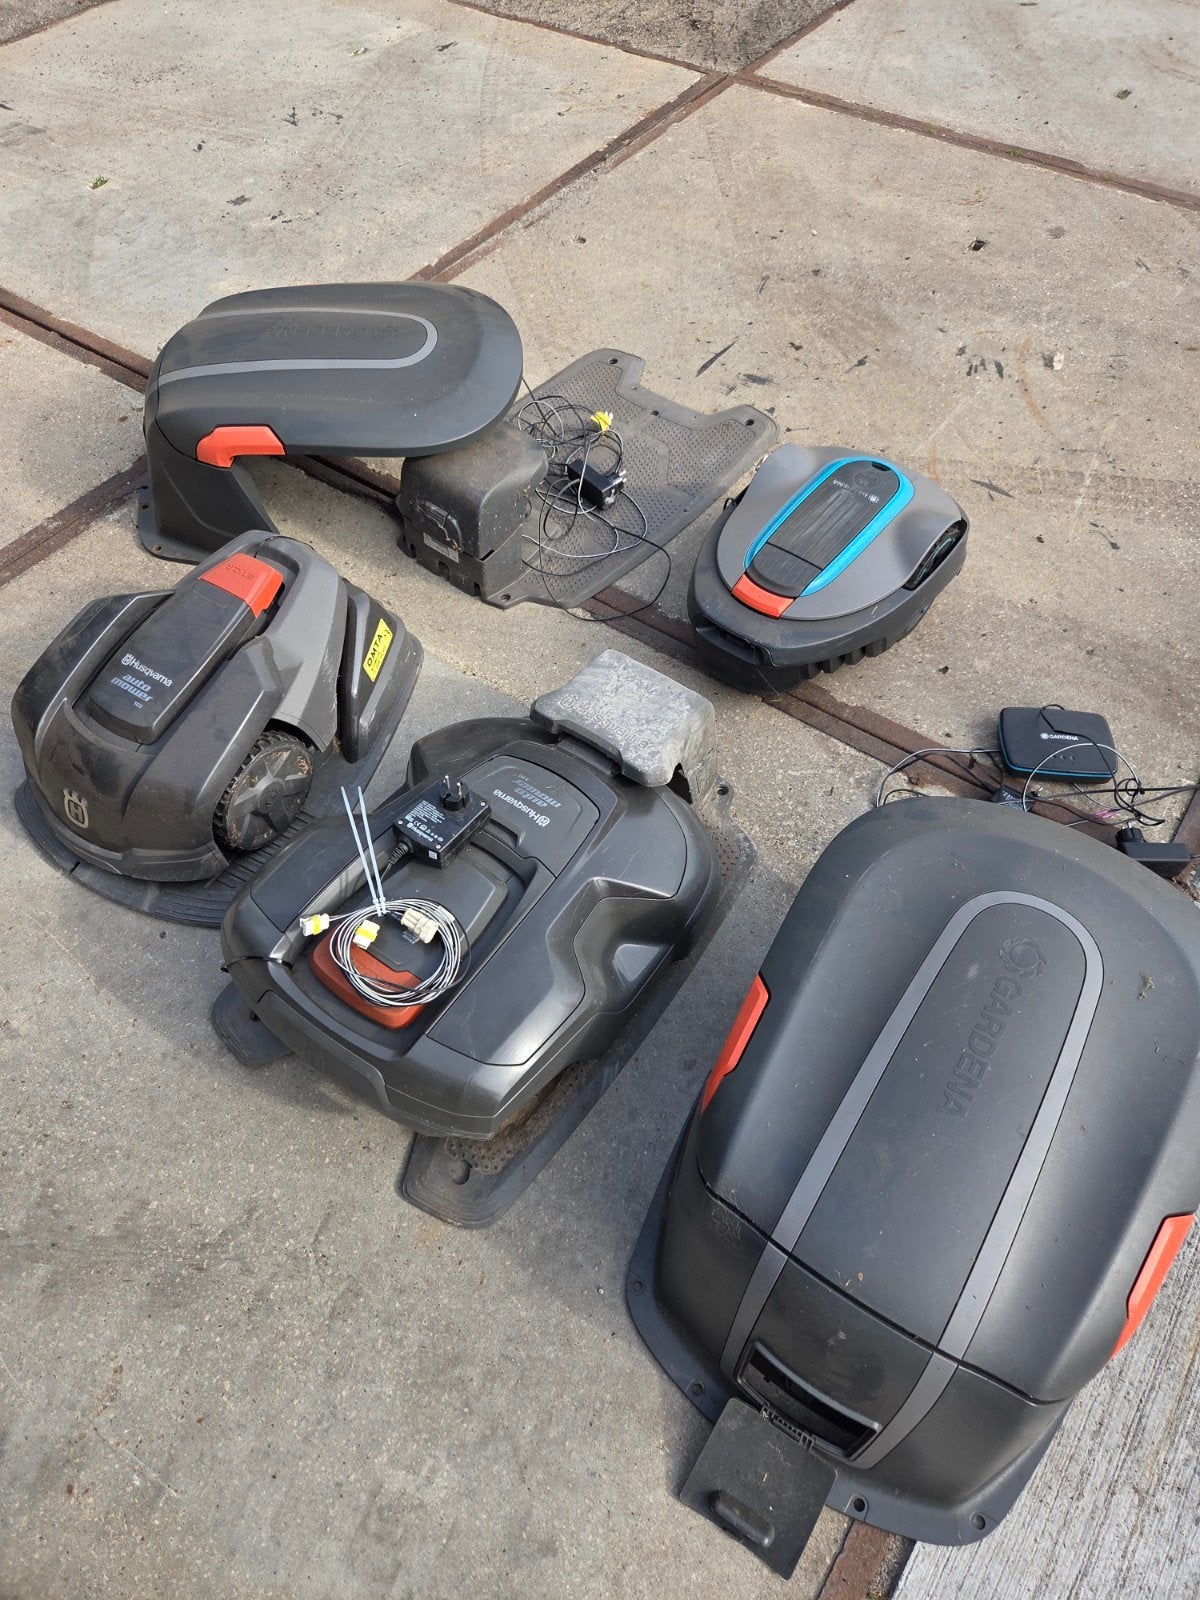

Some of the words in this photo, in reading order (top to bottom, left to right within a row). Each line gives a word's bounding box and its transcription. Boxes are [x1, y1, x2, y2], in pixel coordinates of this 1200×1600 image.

[122, 674, 152, 692] auto
[129, 658, 173, 687] Husqvarna
[110, 677, 154, 702] mower
[493, 789, 541, 821] Husqvarna
[512, 779, 562, 808] mower
[514, 787, 548, 808] auto
[935, 976, 1024, 1120] GARDENA
